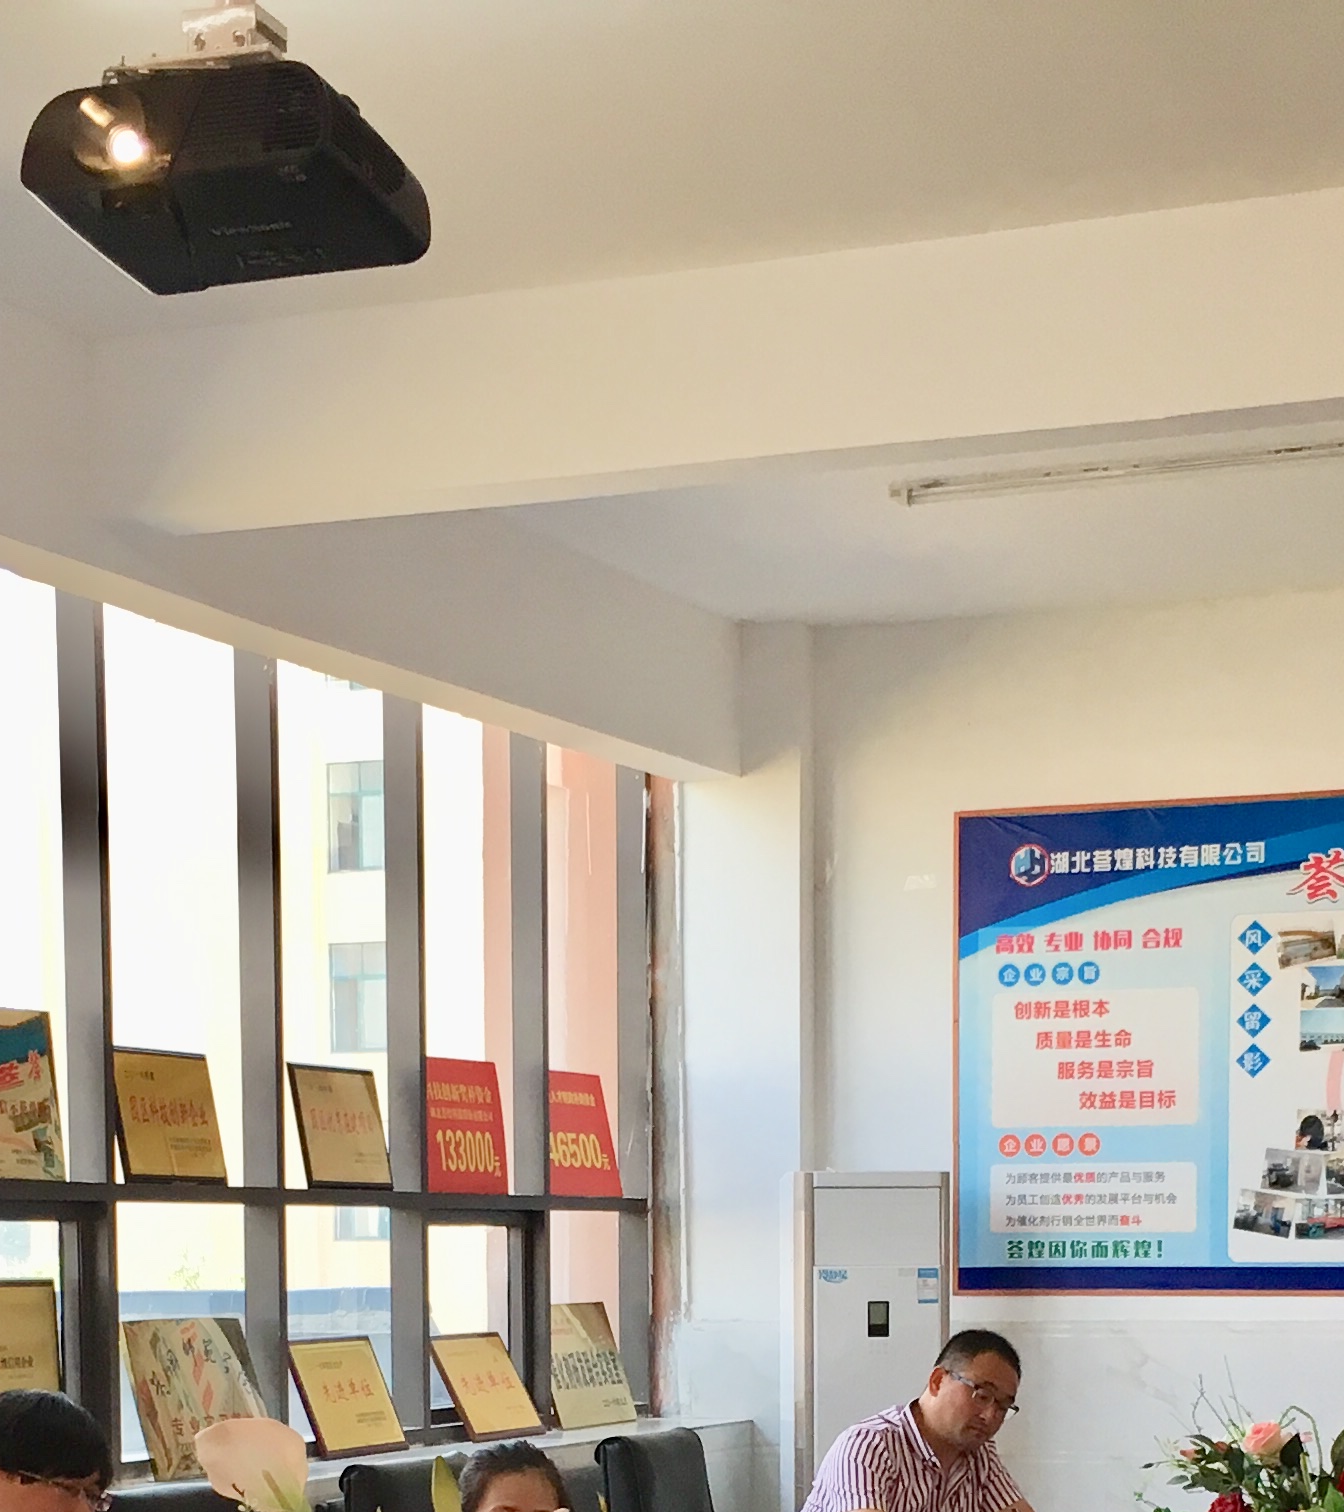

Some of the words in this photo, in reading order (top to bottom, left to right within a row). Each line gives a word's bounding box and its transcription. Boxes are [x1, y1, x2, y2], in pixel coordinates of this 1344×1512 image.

[1050, 842, 1266, 874] 湖北荟煌科技有限公司
[995, 932, 1035, 954] 高效
[1044, 930, 1084, 953] 专业
[1093, 929, 1133, 951] 协同
[1141, 927, 1183, 949] 合规
[1000, 963, 1099, 985] 企业宗旨
[1014, 998, 1111, 1021] 创新是根本
[1242, 927, 1265, 1073] 风采留影
[1035, 1028, 1133, 1051] 质量是生命
[1057, 1059, 1155, 1081] 服务是宗旨
[1078, 1089, 1177, 1111] 效益是目标
[435, 1128, 502, 1178] 133000元
[1001, 1134, 1099, 1154] 企业愿景
[1005, 1170, 1166, 1185] 为顾客提供最优质的产品与服务
[1005, 1192, 1178, 1206] 为员工创造优秀的发展平台与机会
[321, 1377, 375, 1404] 先进单位
